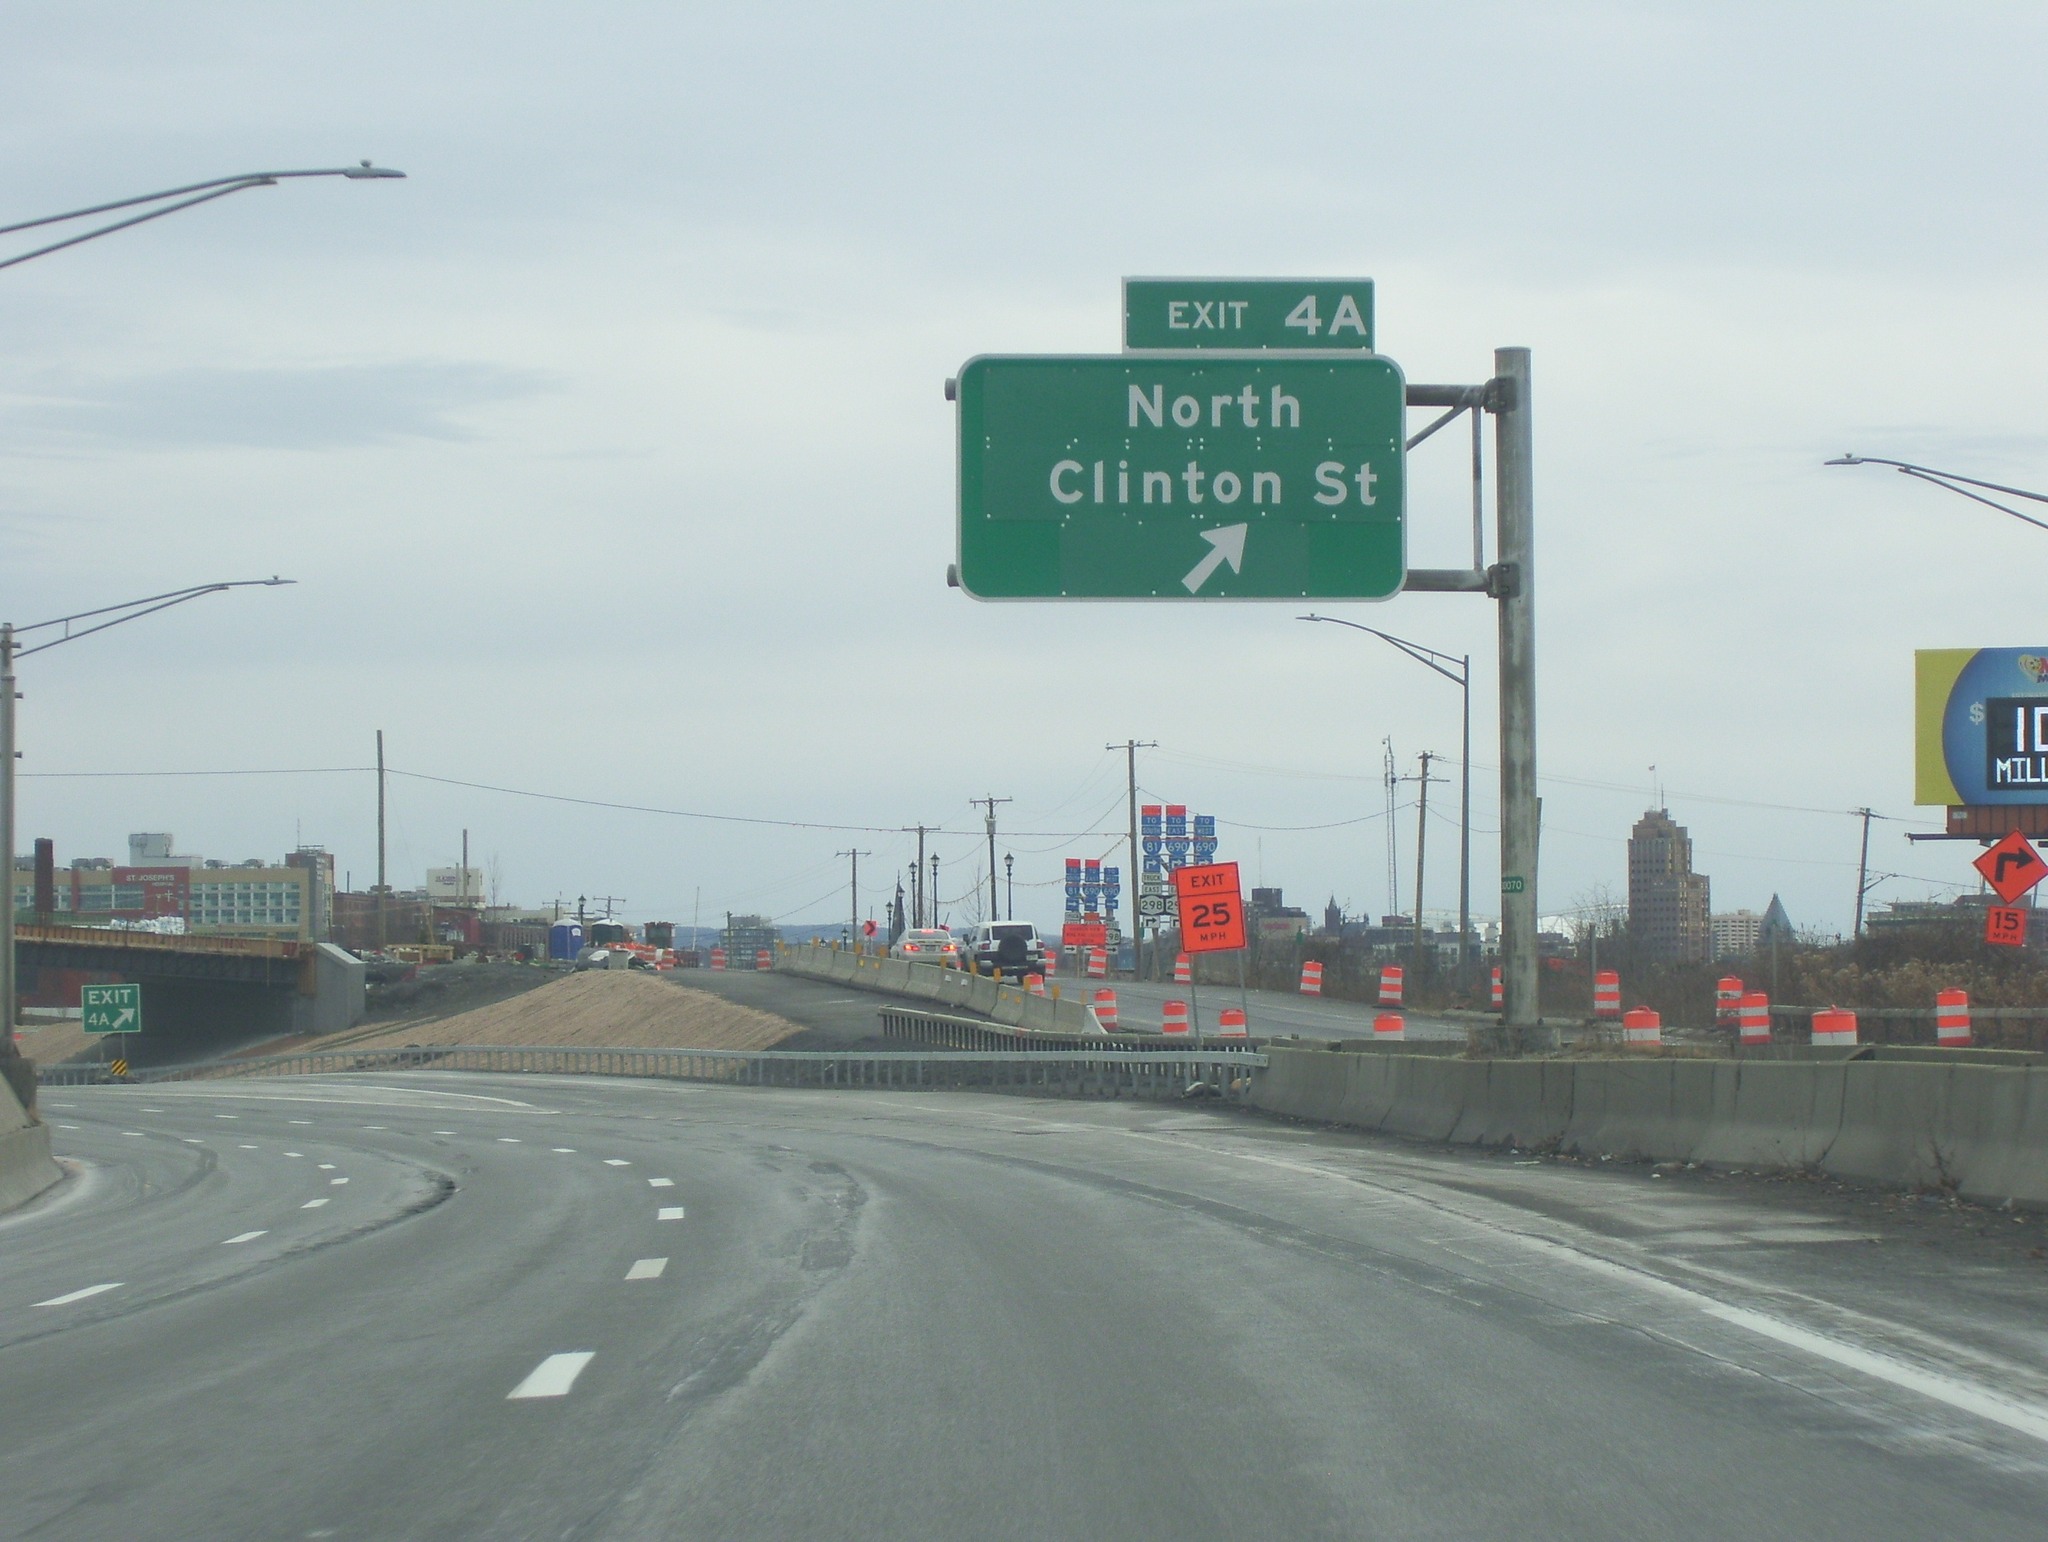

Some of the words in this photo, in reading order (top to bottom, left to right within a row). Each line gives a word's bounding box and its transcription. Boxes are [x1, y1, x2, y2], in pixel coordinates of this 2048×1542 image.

[1168, 301, 1249, 329] EXIT
[1284, 295, 1368, 336] 4A
[1128, 384, 1300, 428] North
[1049, 459, 1282, 504] Clinton
[1313, 461, 1378, 506] St
[1969, 701, 1984, 726] $
[1168, 827, 1185, 835] EAST
[1146, 842, 1158, 852] 81
[1168, 842, 1188, 852] 690
[1196, 842, 1216, 852] 690
[1143, 874, 1161, 882] TRUCK
[1191, 873, 1225, 888] EXIT
[1070, 887, 1078, 895] 81
[1084, 887, 1101, 895] 690
[1103, 887, 1119, 896] 690
[1141, 900, 1163, 910] 298
[1191, 902, 1231, 928] 25
[1995, 911, 2019, 931] 15
[1200, 932, 1227, 942] MPH
[1993, 932, 2017, 941] MPH
[88, 989, 131, 1005] EXIT
[88, 1012, 110, 1026] 4A
